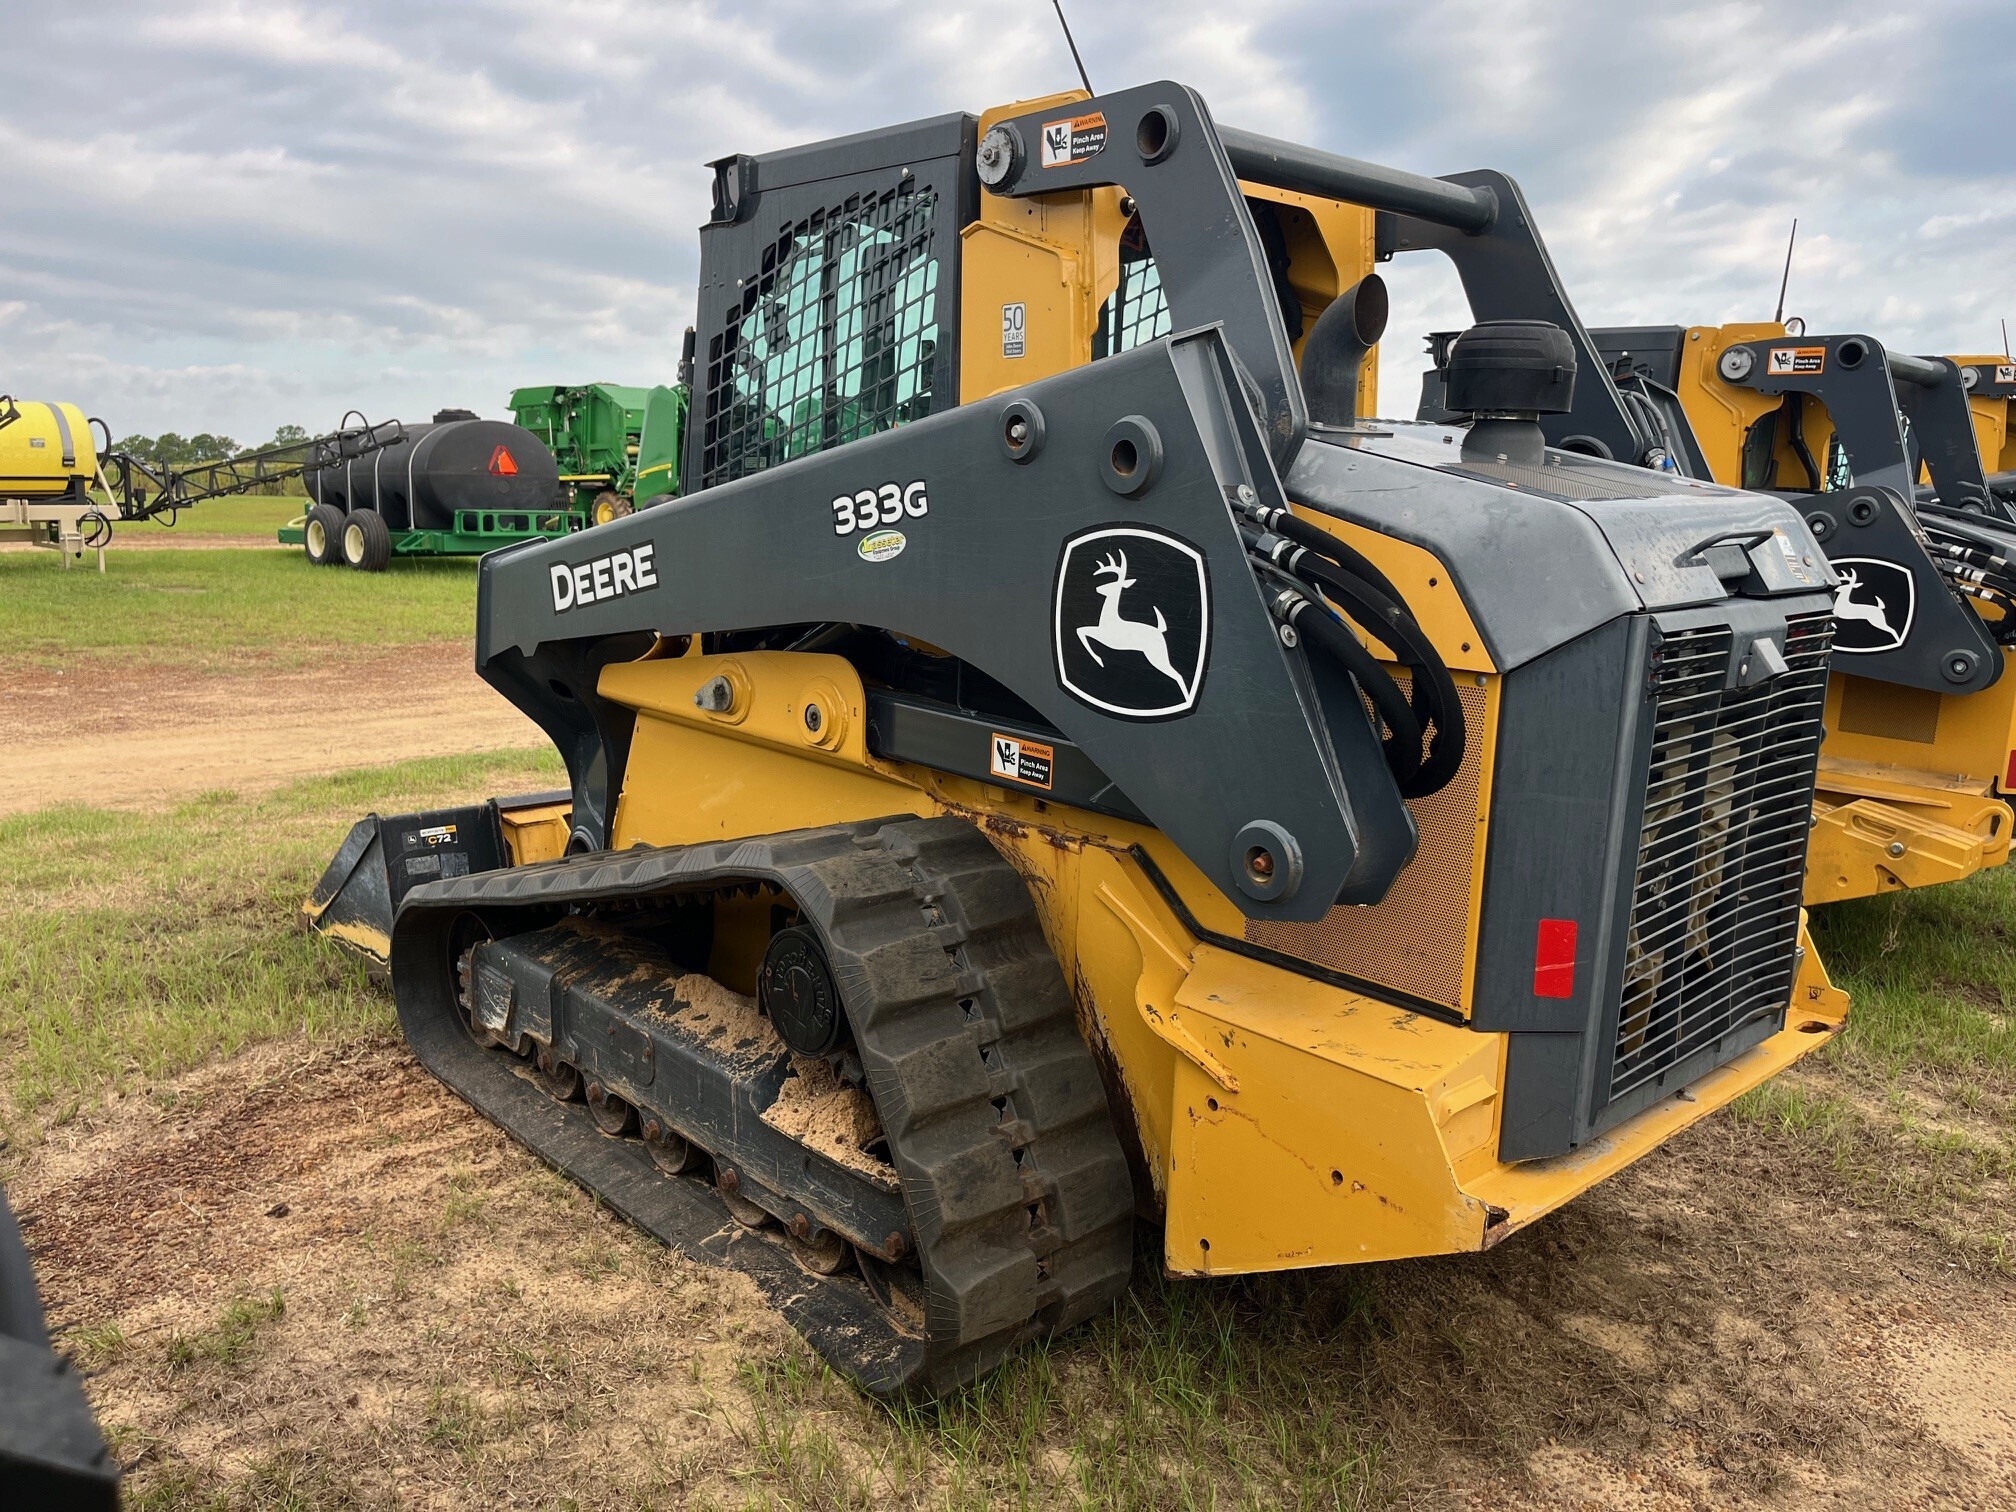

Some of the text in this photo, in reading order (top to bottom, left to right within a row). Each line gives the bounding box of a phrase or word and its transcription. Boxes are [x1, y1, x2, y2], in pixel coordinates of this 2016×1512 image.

[1072, 133, 1104, 145] Pinch Area
[1072, 144, 1100, 155] Keep Away
[1003, 305, 1024, 332] 50
[1003, 331, 1024, 341] YEARS
[832, 480, 928, 535] 333G
[863, 535, 904, 553] Lasseter
[549, 543, 658, 612] DEERE
[1026, 744, 1051, 757] WARNING
[1020, 759, 1049, 772] Pinch Area
[1020, 768, 1044, 780] Keep Away
[428, 834, 451, 844] C72
